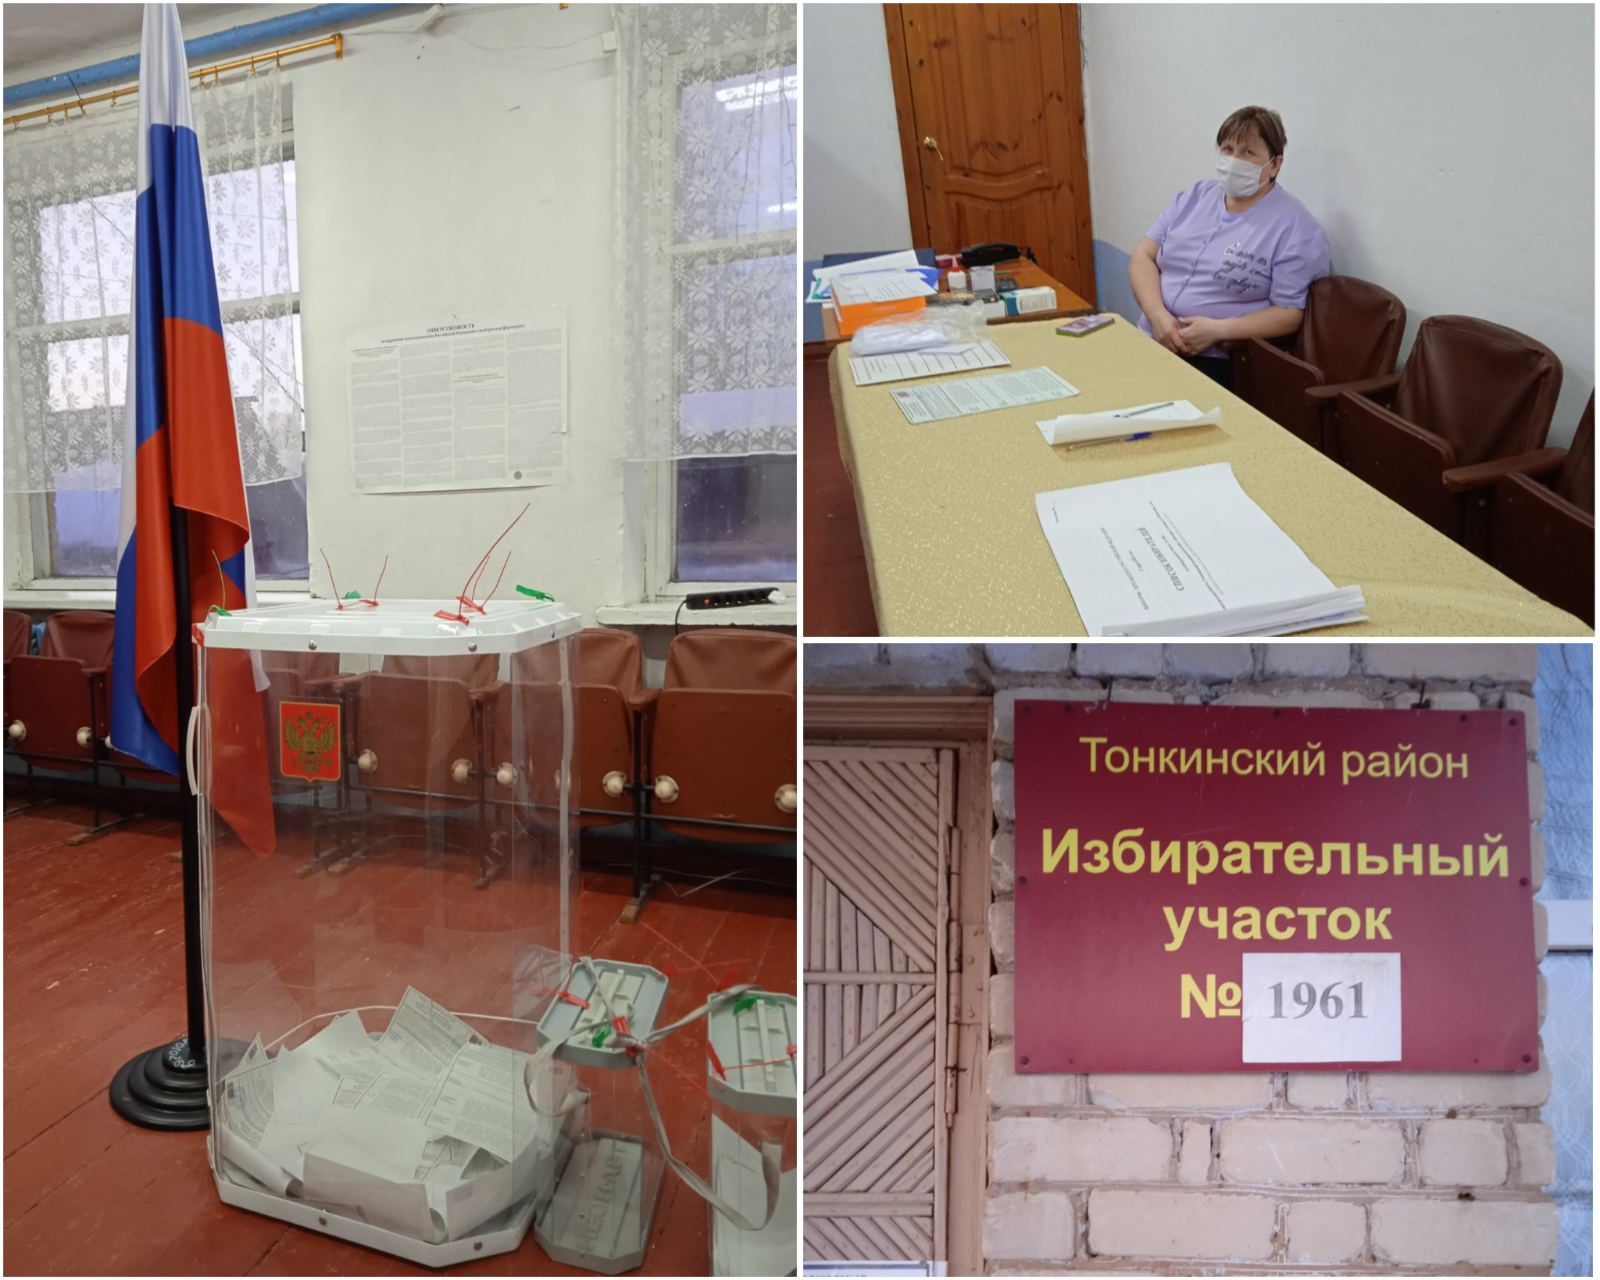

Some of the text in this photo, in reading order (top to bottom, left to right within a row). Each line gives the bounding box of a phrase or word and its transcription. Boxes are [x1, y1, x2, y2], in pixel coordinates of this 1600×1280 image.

[1080, 738, 1469, 784] Тонкинский район
[1041, 828, 1510, 884] Избирательный
[1163, 905, 1393, 951] участок
[1180, 973, 1368, 1019] № 1961
